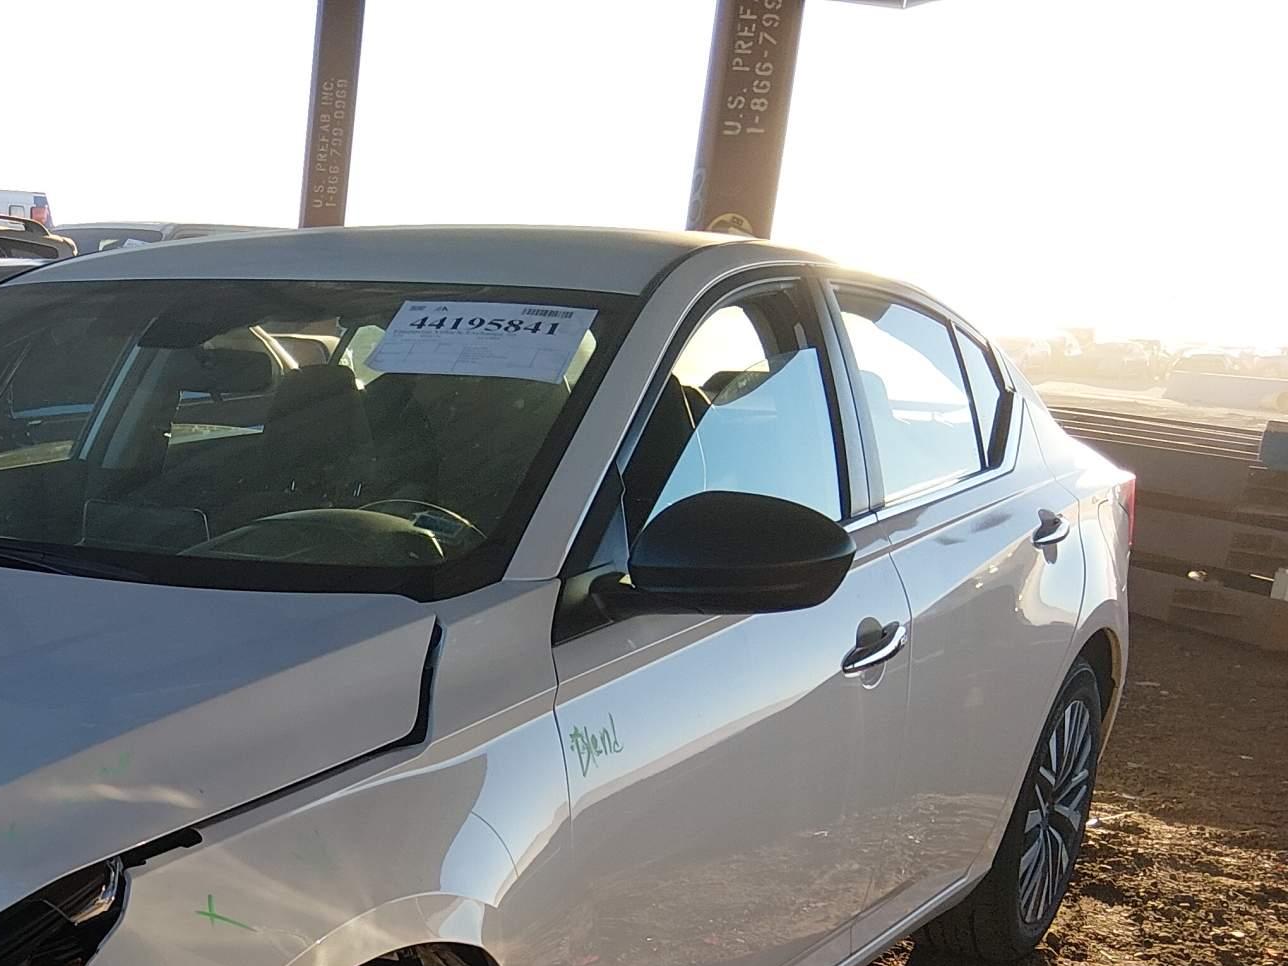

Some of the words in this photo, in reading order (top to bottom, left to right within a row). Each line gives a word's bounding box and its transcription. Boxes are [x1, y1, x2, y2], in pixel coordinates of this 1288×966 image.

[732, 0, 758, 72] PREF
[320, 78, 335, 106] INC.
[722, 88, 747, 136] U.S.
[316, 114, 331, 172] PREFAB
[312, 180, 326, 208] U.S.
[409, 316, 560, 336] 44195841
